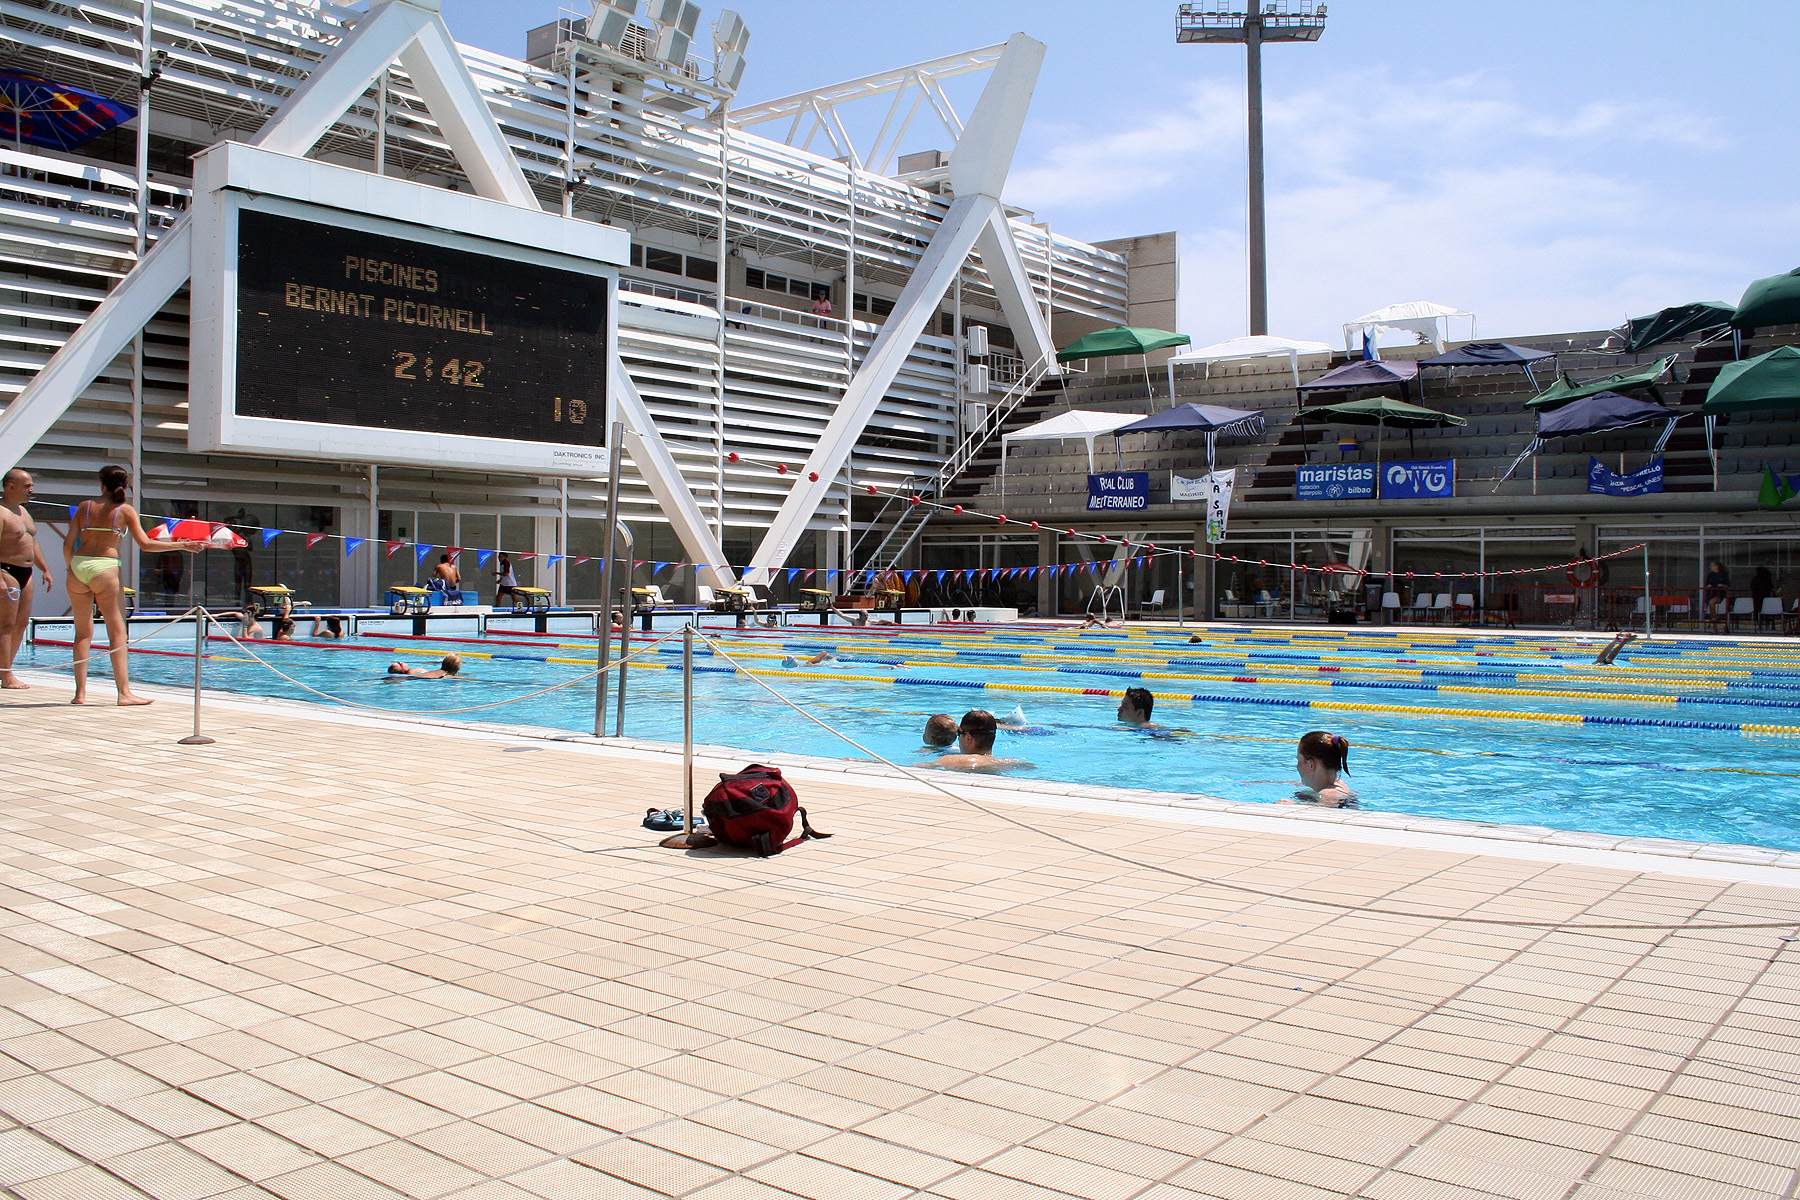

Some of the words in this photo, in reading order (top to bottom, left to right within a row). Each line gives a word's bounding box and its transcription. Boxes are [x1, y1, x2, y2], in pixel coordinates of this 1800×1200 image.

[345, 255, 438, 293] PISCINES
[285, 282, 375, 318] BERNAT
[383, 297, 494, 336] PICORNELL
[394, 351, 485, 388] 2:42
[553, 451, 593, 460] DAKTRONICS
[1299, 466, 1373, 482] maristas
[1117, 475, 1135, 490] CLUB
[1347, 486, 1372, 494] bilbao
[1088, 494, 1145, 509] METERRANEO
